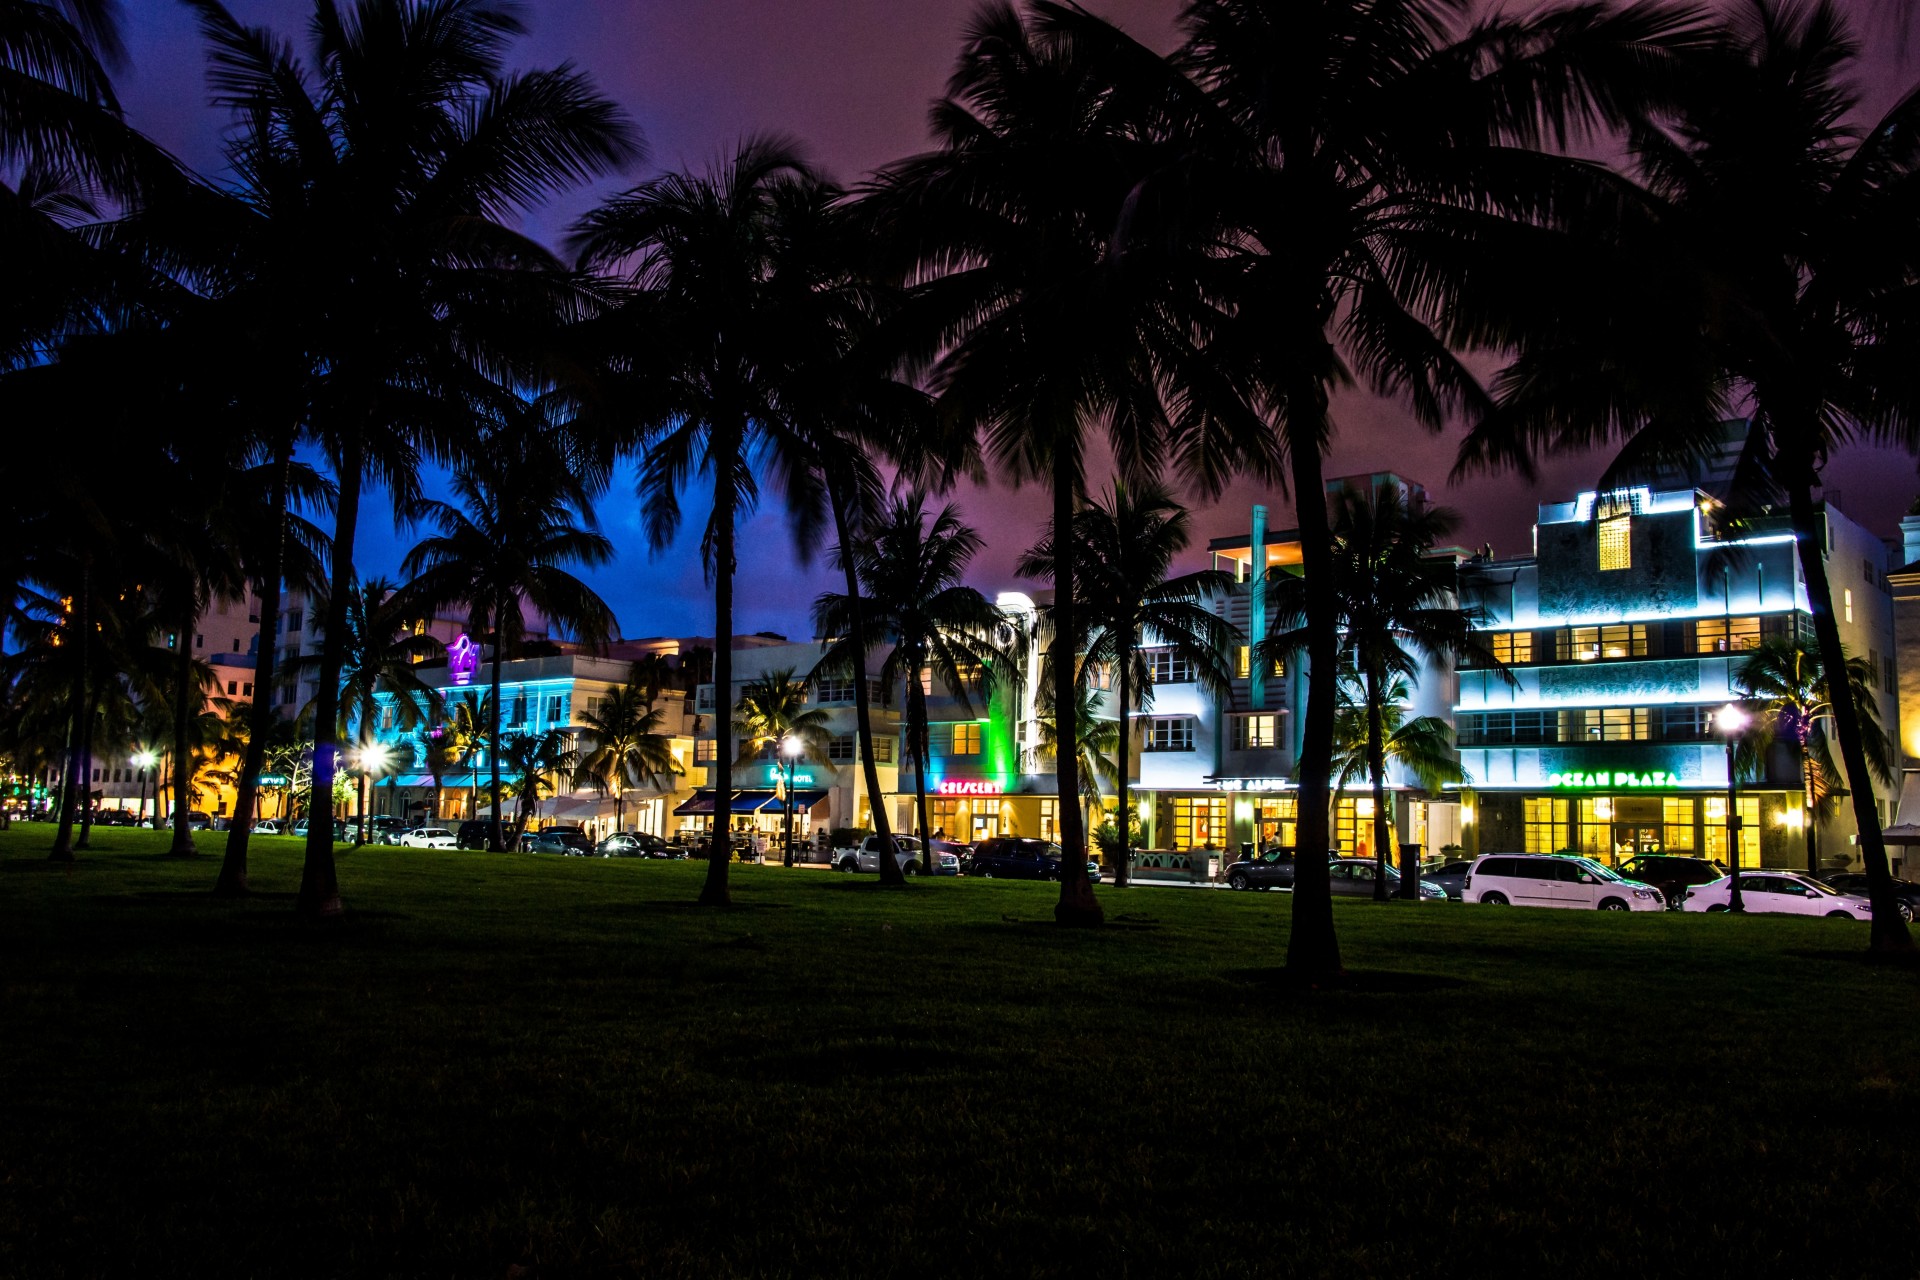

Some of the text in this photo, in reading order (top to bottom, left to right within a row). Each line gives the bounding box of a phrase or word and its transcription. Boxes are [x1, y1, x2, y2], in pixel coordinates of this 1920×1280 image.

[1549, 771, 1678, 786] OCEAN PLAZA
[939, 782, 1002, 794] CRESCENT
